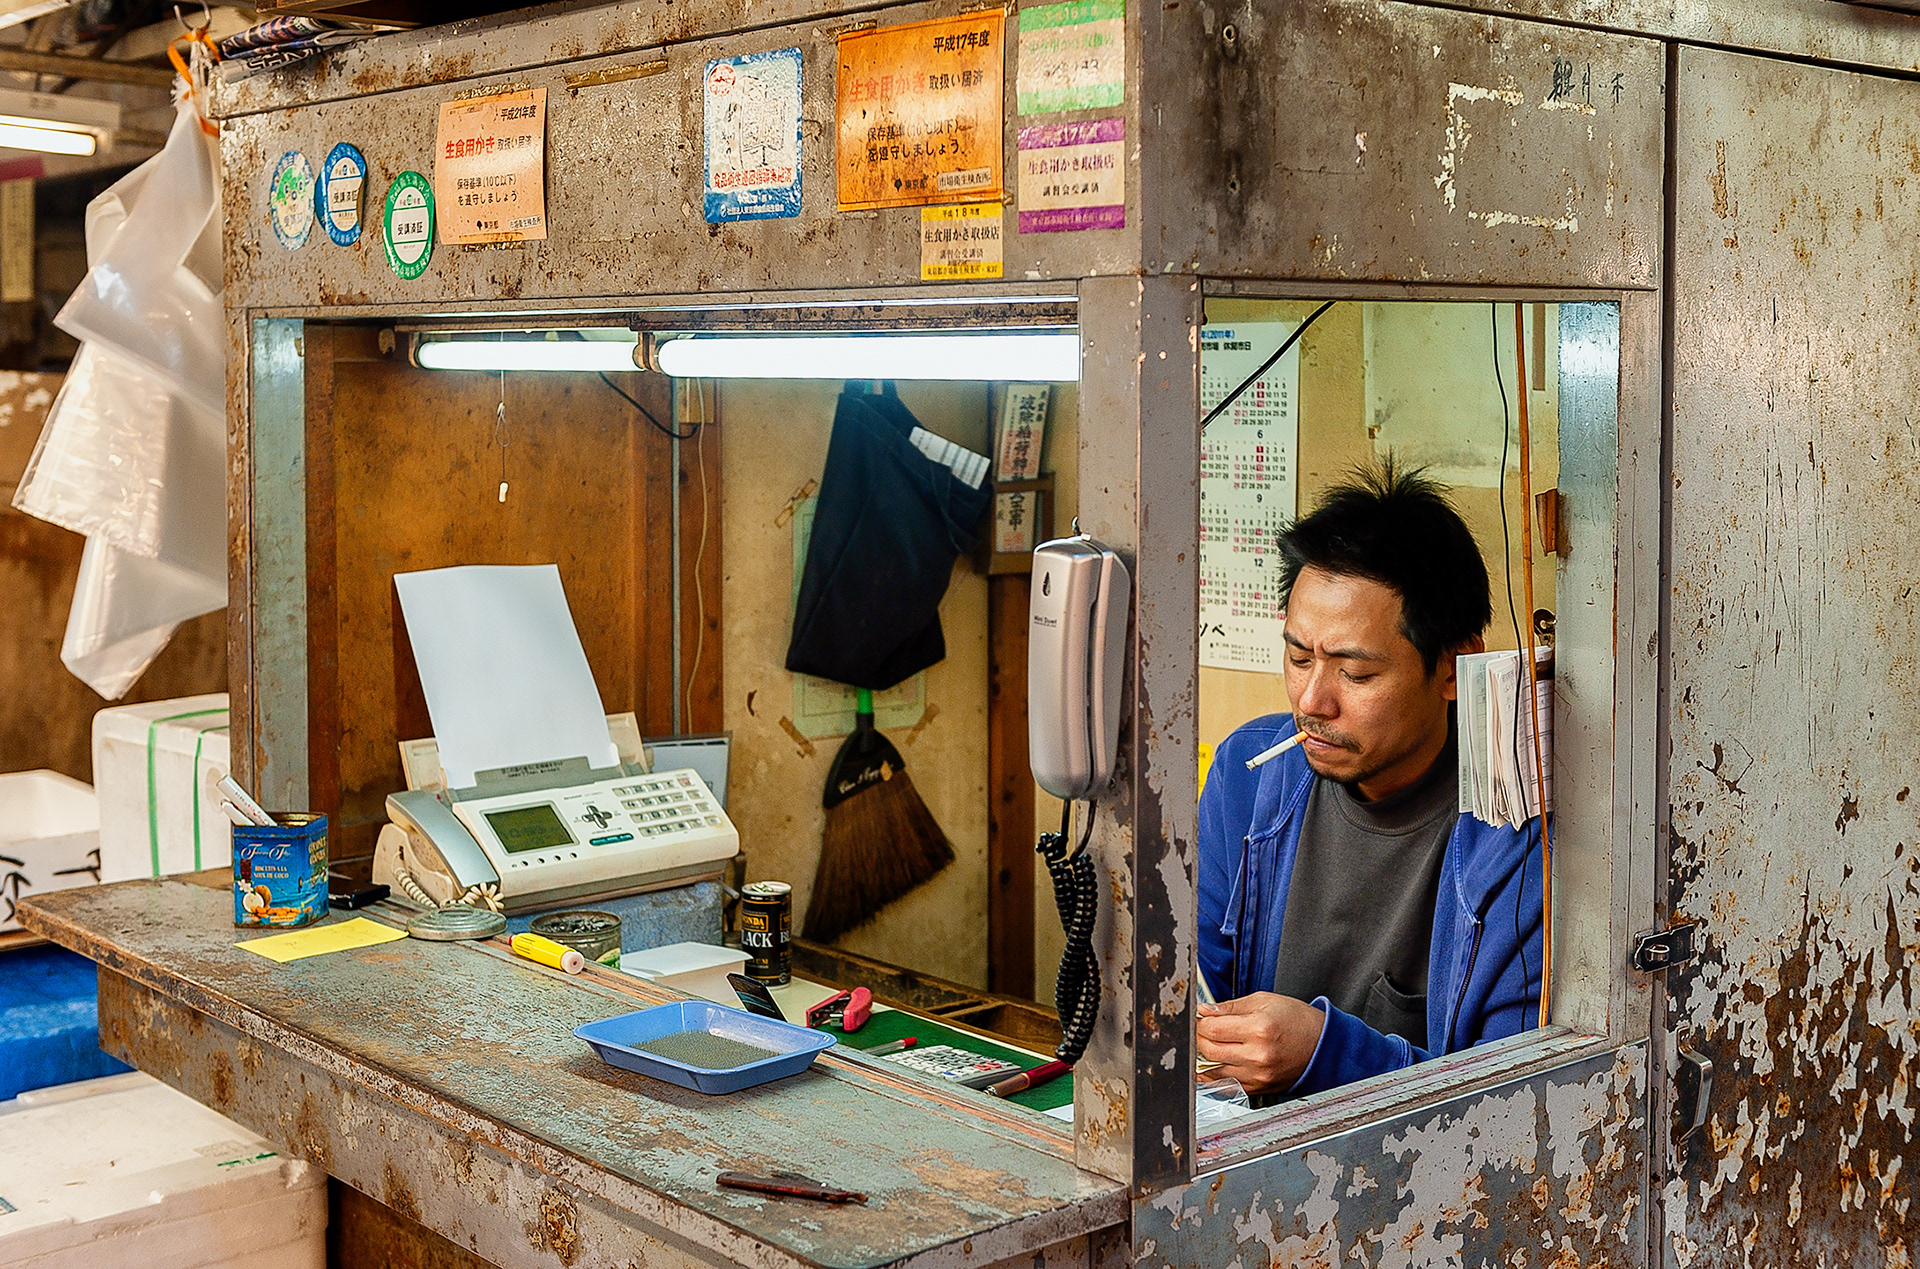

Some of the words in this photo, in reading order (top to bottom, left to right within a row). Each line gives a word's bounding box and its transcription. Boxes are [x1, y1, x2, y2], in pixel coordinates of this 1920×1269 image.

[933, 30, 990, 54] 平成17年度
[850, 71, 926, 102] 生食用かき
[929, 68, 984, 90] 取扱い届済
[500, 104, 538, 122] 平成21年度
[445, 136, 495, 160] 生食用かき
[1028, 154, 1114, 175] 生食用かき取扱店
[398, 221, 423, 236] 受講済証
[924, 226, 1000, 242] 生食用かき取扱店
[1257, 430, 1264, 438] 6
[1257, 494, 1262, 503] 9
[1254, 559, 1264, 567] 12
